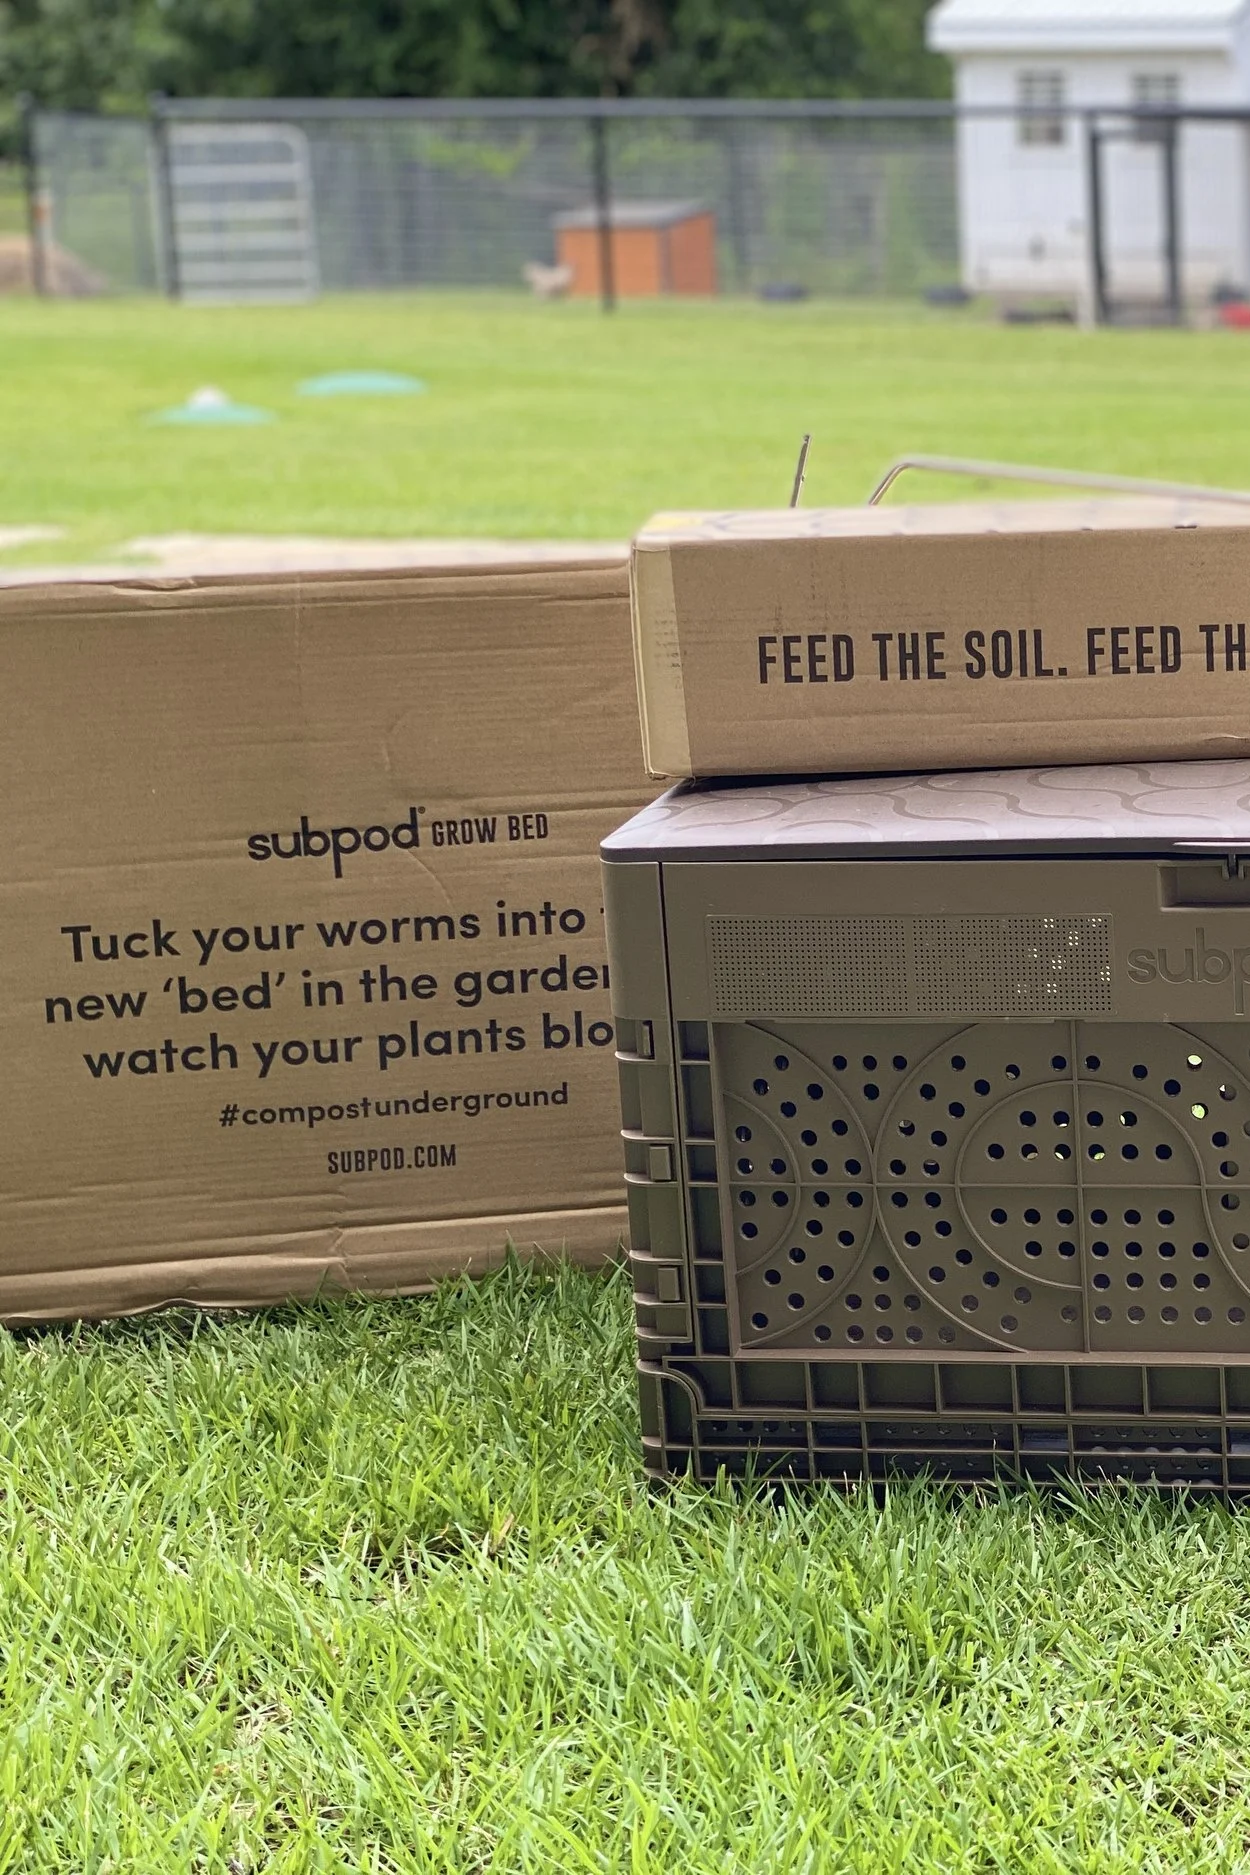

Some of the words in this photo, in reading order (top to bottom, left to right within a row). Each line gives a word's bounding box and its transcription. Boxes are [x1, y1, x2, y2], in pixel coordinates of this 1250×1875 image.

[759, 634, 854, 684] FEED
[872, 632, 946, 681] THE
[965, 629, 1067, 679] SOIL.
[1087, 626, 1181, 675] FEED
[432, 816, 497, 847] GROW
[508, 813, 549, 841] BED
[61, 919, 180, 963] Tuck
[193, 924, 304, 966] your
[316, 914, 480, 948] worms
[497, 900, 585, 938] into
[45, 989, 147, 1024] new
[302, 969, 343, 1007] in
[359, 965, 437, 1003] the
[83, 1033, 238, 1078] watch
[252, 1036, 362, 1078] your
[379, 1019, 525, 1070] plants
[219, 1082, 569, 1128] #compostunderground
[327, 1144, 457, 1175] SUBPOD.COM
